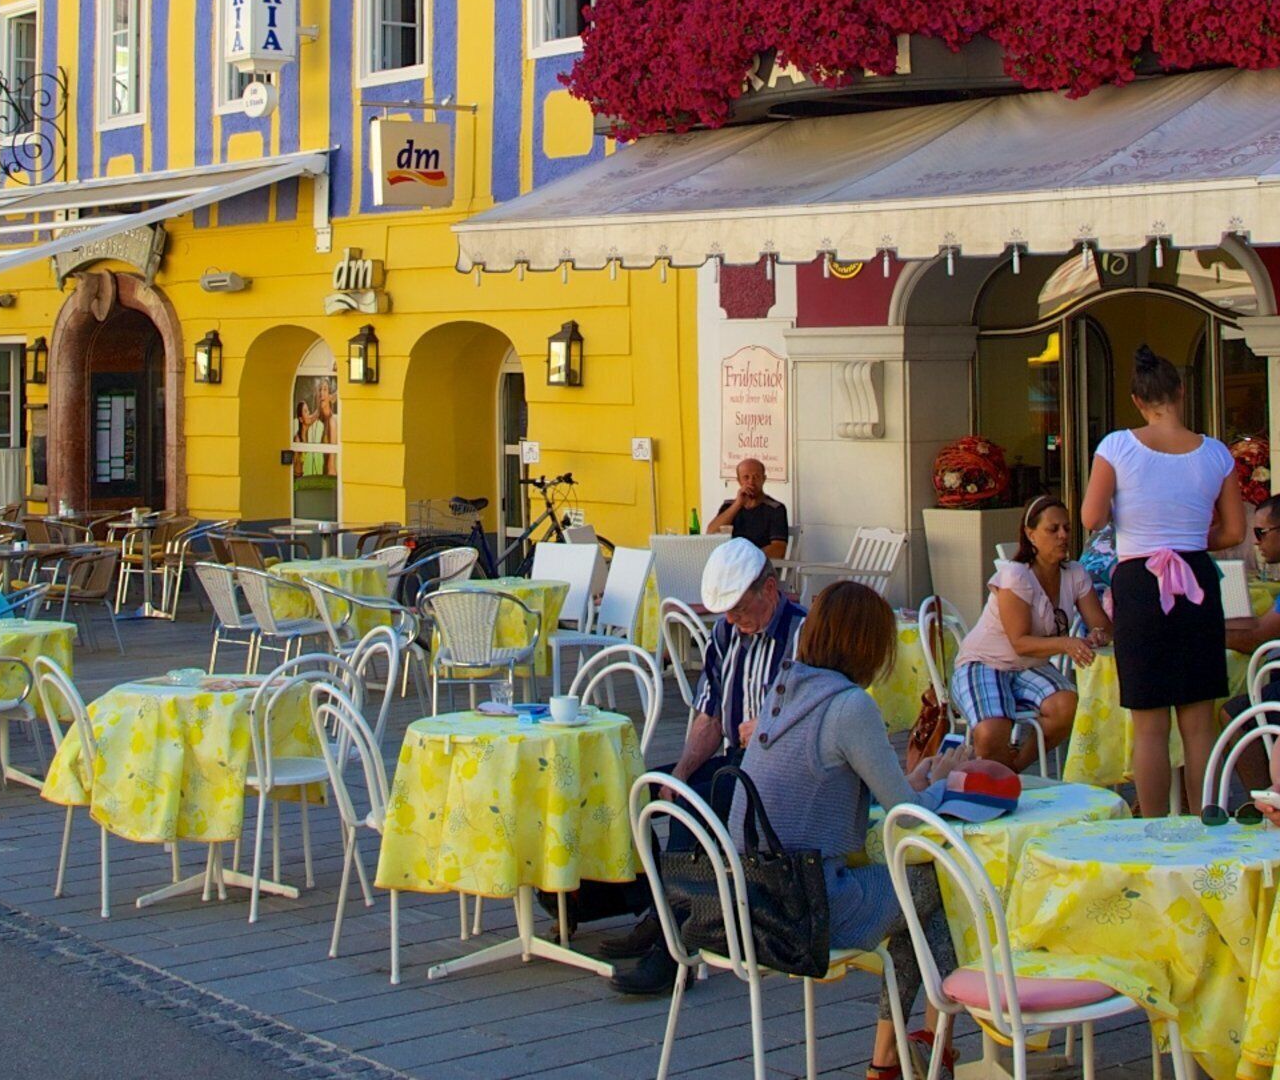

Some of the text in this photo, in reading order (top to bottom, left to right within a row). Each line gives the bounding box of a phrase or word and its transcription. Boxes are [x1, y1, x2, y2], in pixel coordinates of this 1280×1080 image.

[396, 139, 440, 170] dm
[333, 247, 376, 290] dm
[723, 360, 784, 391] Frühstück
[735, 411, 772, 432] Suppen
[738, 429, 769, 448] Salate
